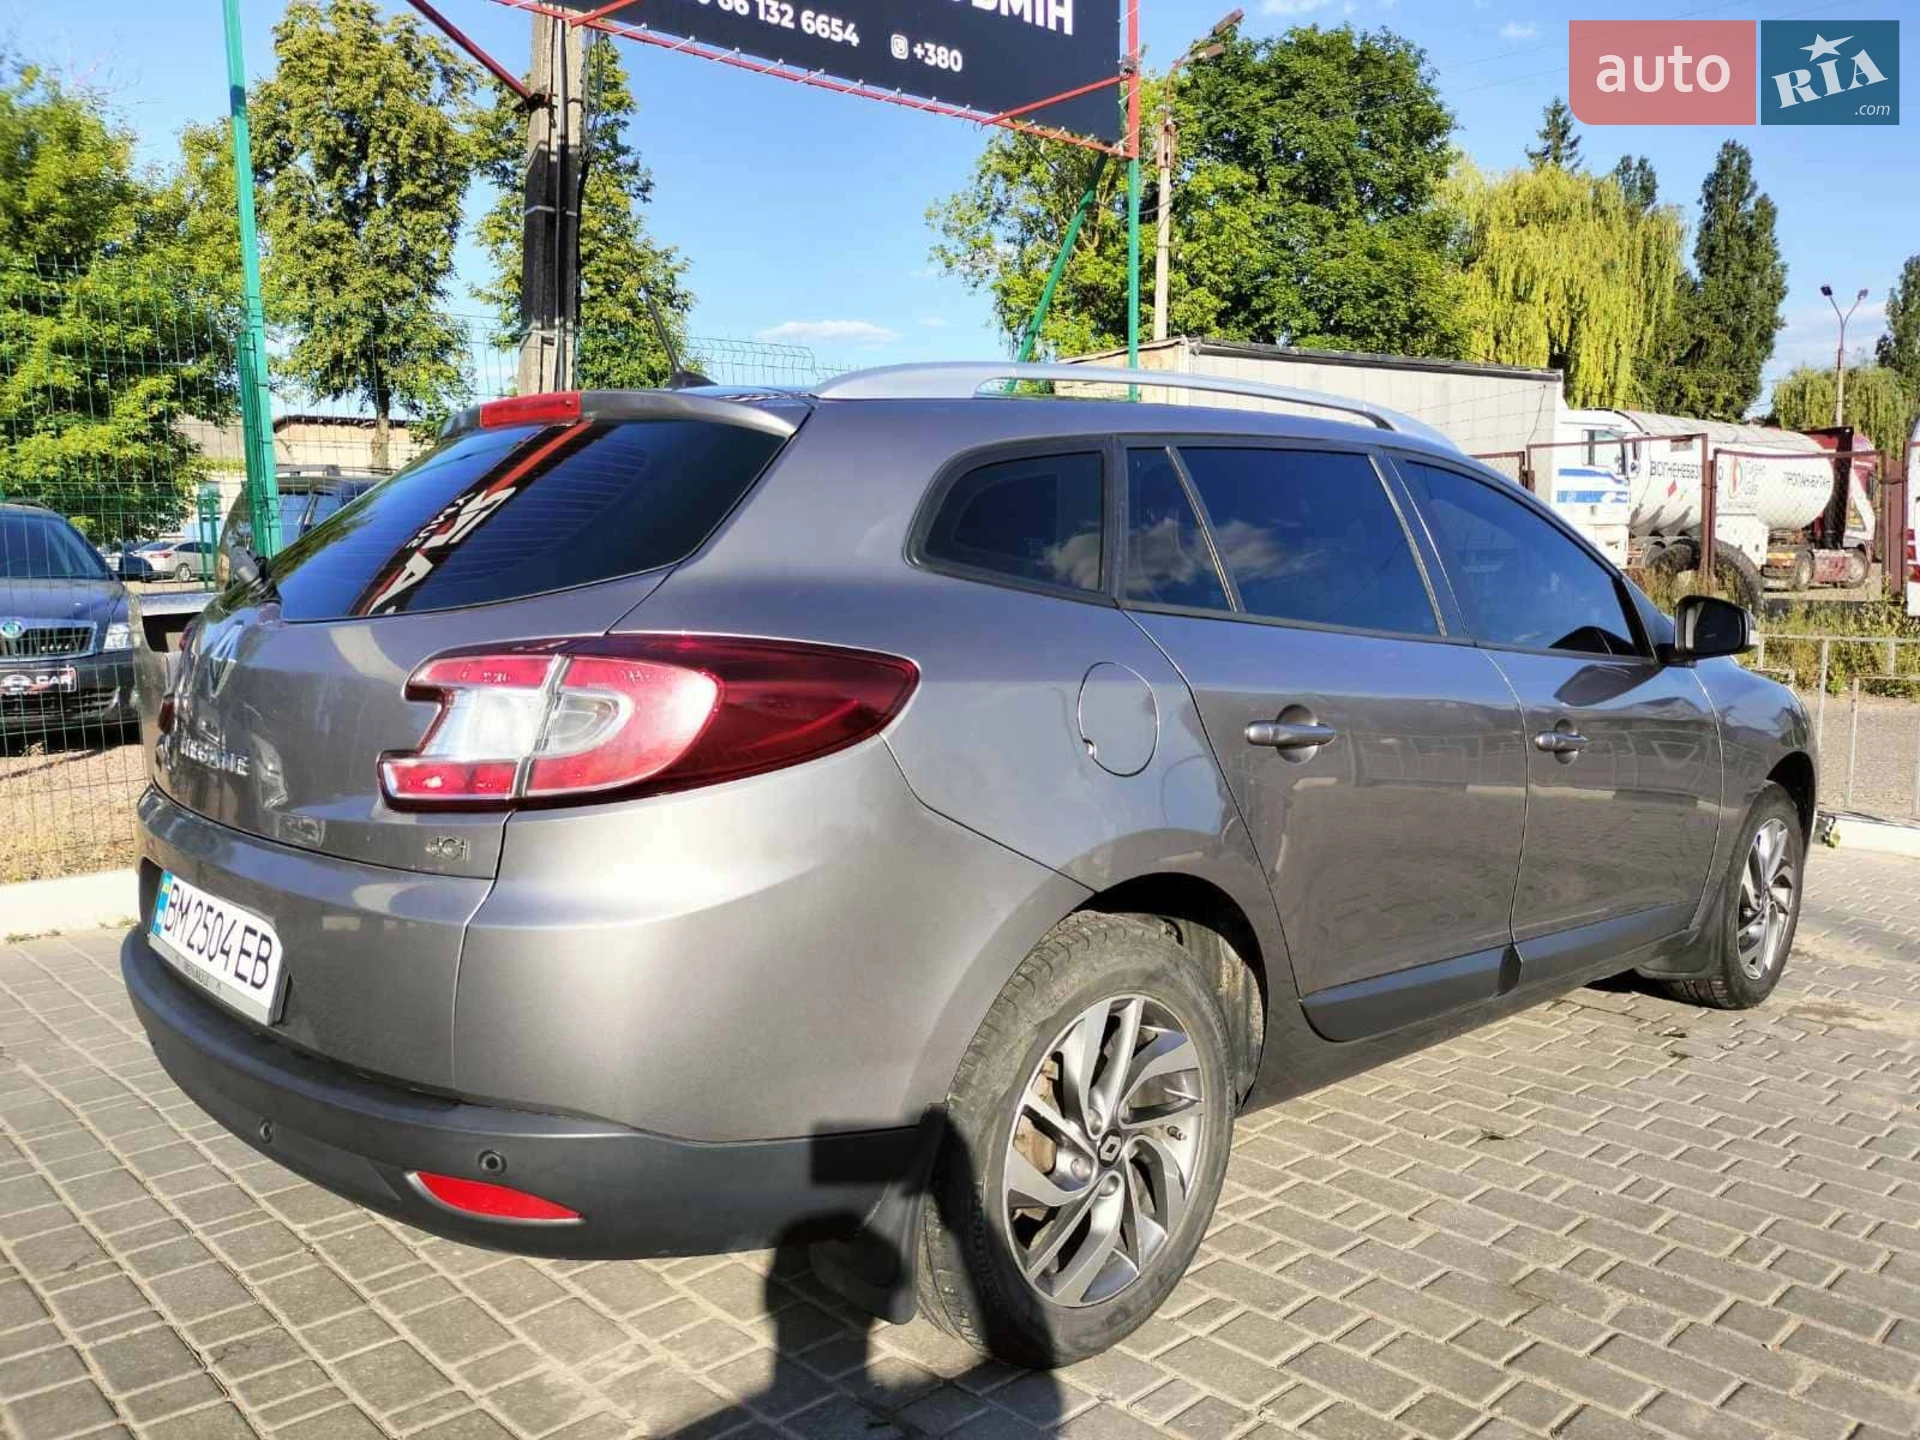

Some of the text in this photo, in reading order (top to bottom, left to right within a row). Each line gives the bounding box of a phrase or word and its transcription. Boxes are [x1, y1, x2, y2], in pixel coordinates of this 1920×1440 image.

[756, 0, 795, 30] 132
[800, 10, 860, 48] 6654
[912, 42, 963, 73] +380
[164, 883, 273, 990] BM 2504 EB
